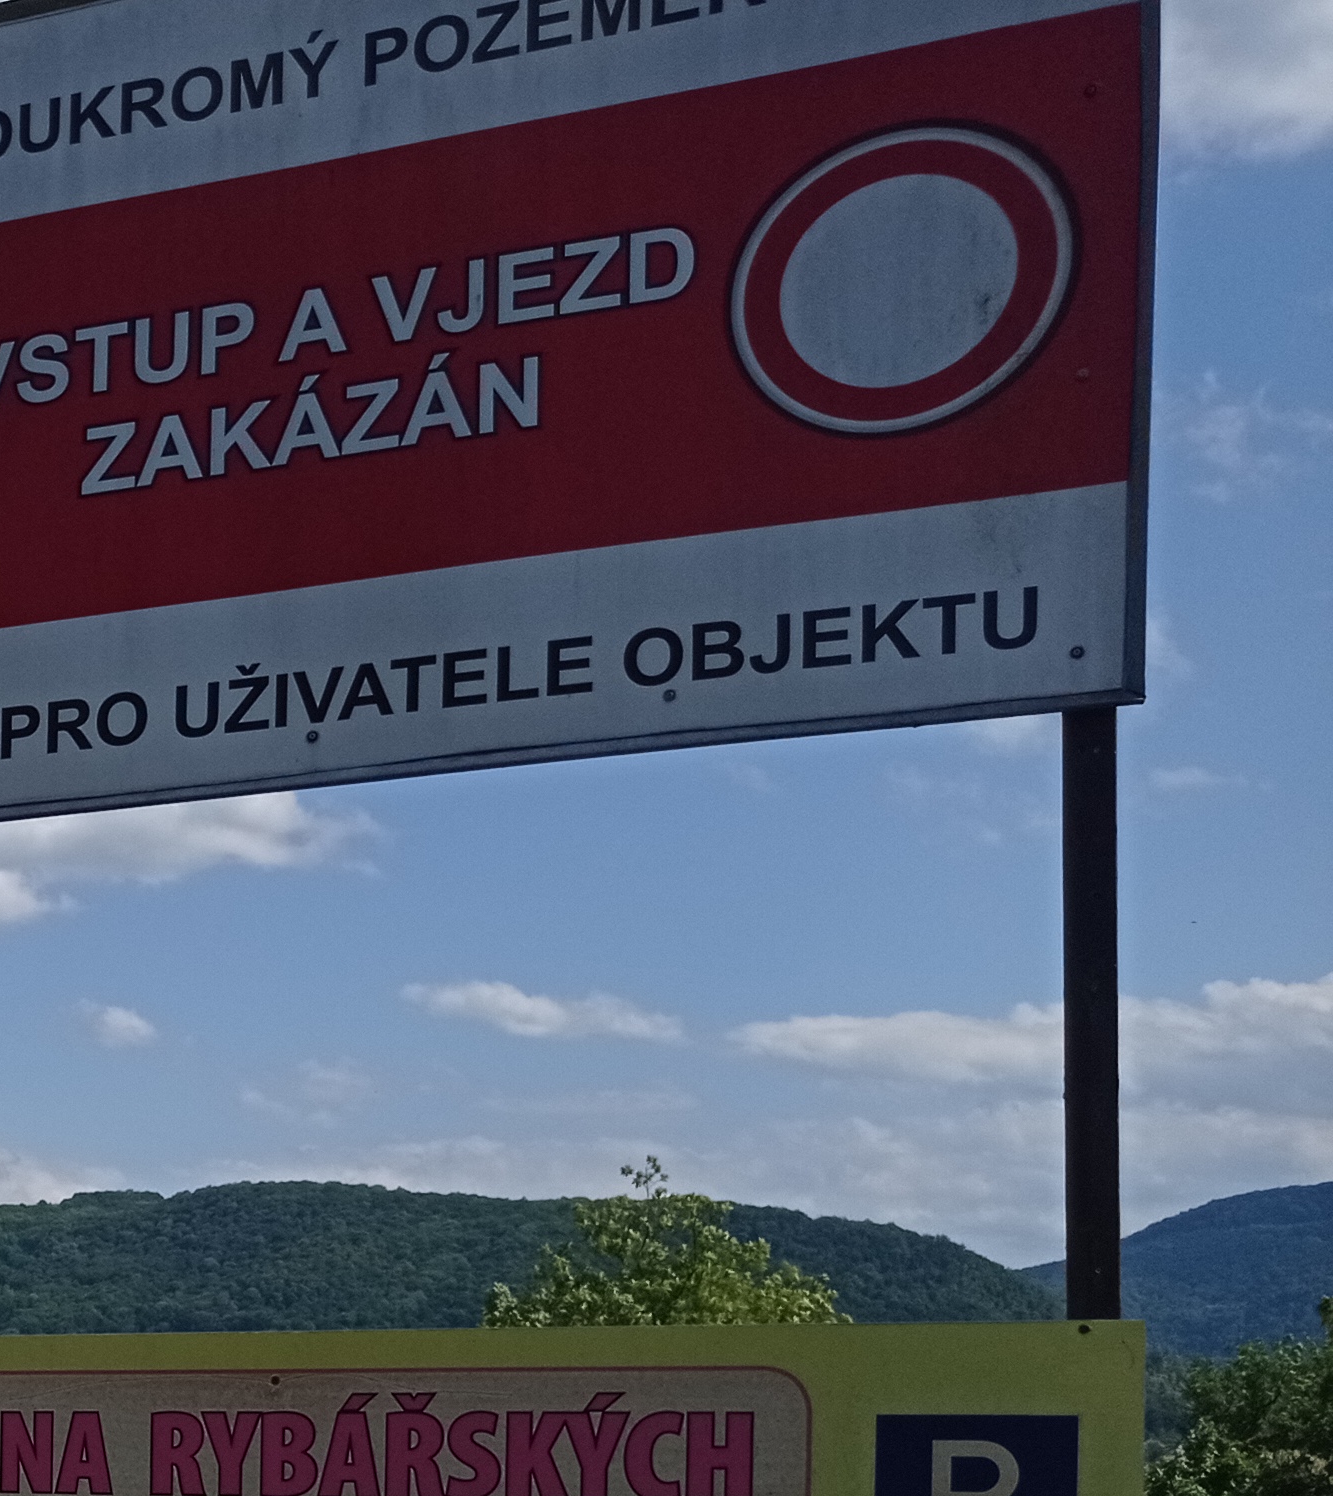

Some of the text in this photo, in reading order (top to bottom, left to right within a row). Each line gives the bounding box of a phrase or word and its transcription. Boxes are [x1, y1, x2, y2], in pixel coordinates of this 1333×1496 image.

[364, 0, 767, 87] POZEM
[279, 287, 347, 362] A
[372, 226, 696, 343] VJEZD
[80, 353, 539, 495] ZAKÁZÁN
[0, 690, 148, 760] PRO
[175, 635, 593, 738] UŽIVATELE
[623, 586, 1039, 688] OBJEKTU
